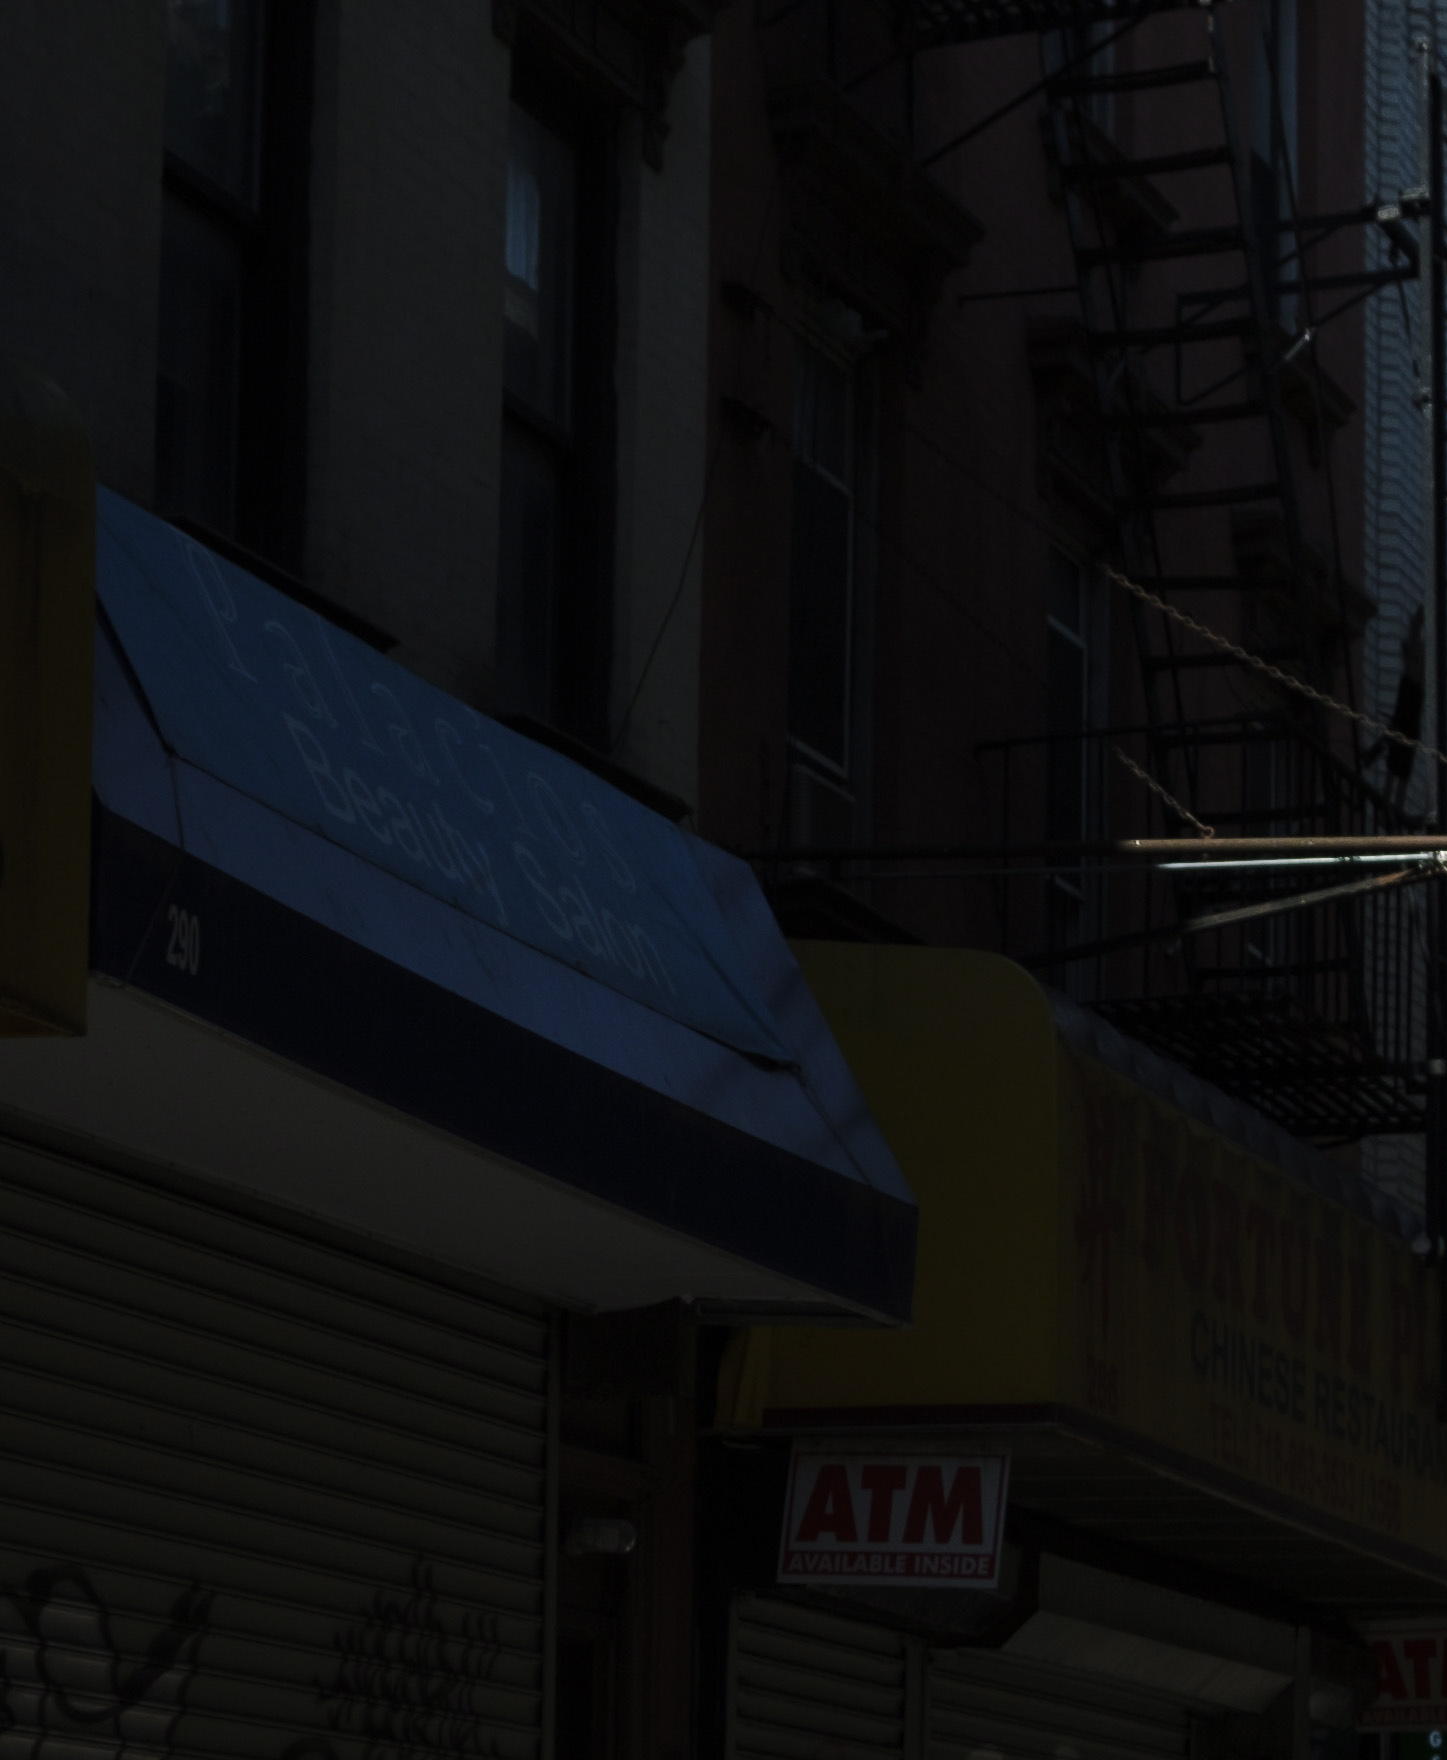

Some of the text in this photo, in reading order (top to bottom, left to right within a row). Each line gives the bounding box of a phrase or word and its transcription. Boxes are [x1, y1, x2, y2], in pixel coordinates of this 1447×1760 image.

[283, 708, 679, 998] Beauty Salon
[163, 902, 201, 979] 290
[1189, 1309, 1308, 1424] CHINESE
[795, 1463, 985, 1546] ATM
[787, 1553, 992, 1577] AVAILABLE INSIDE
